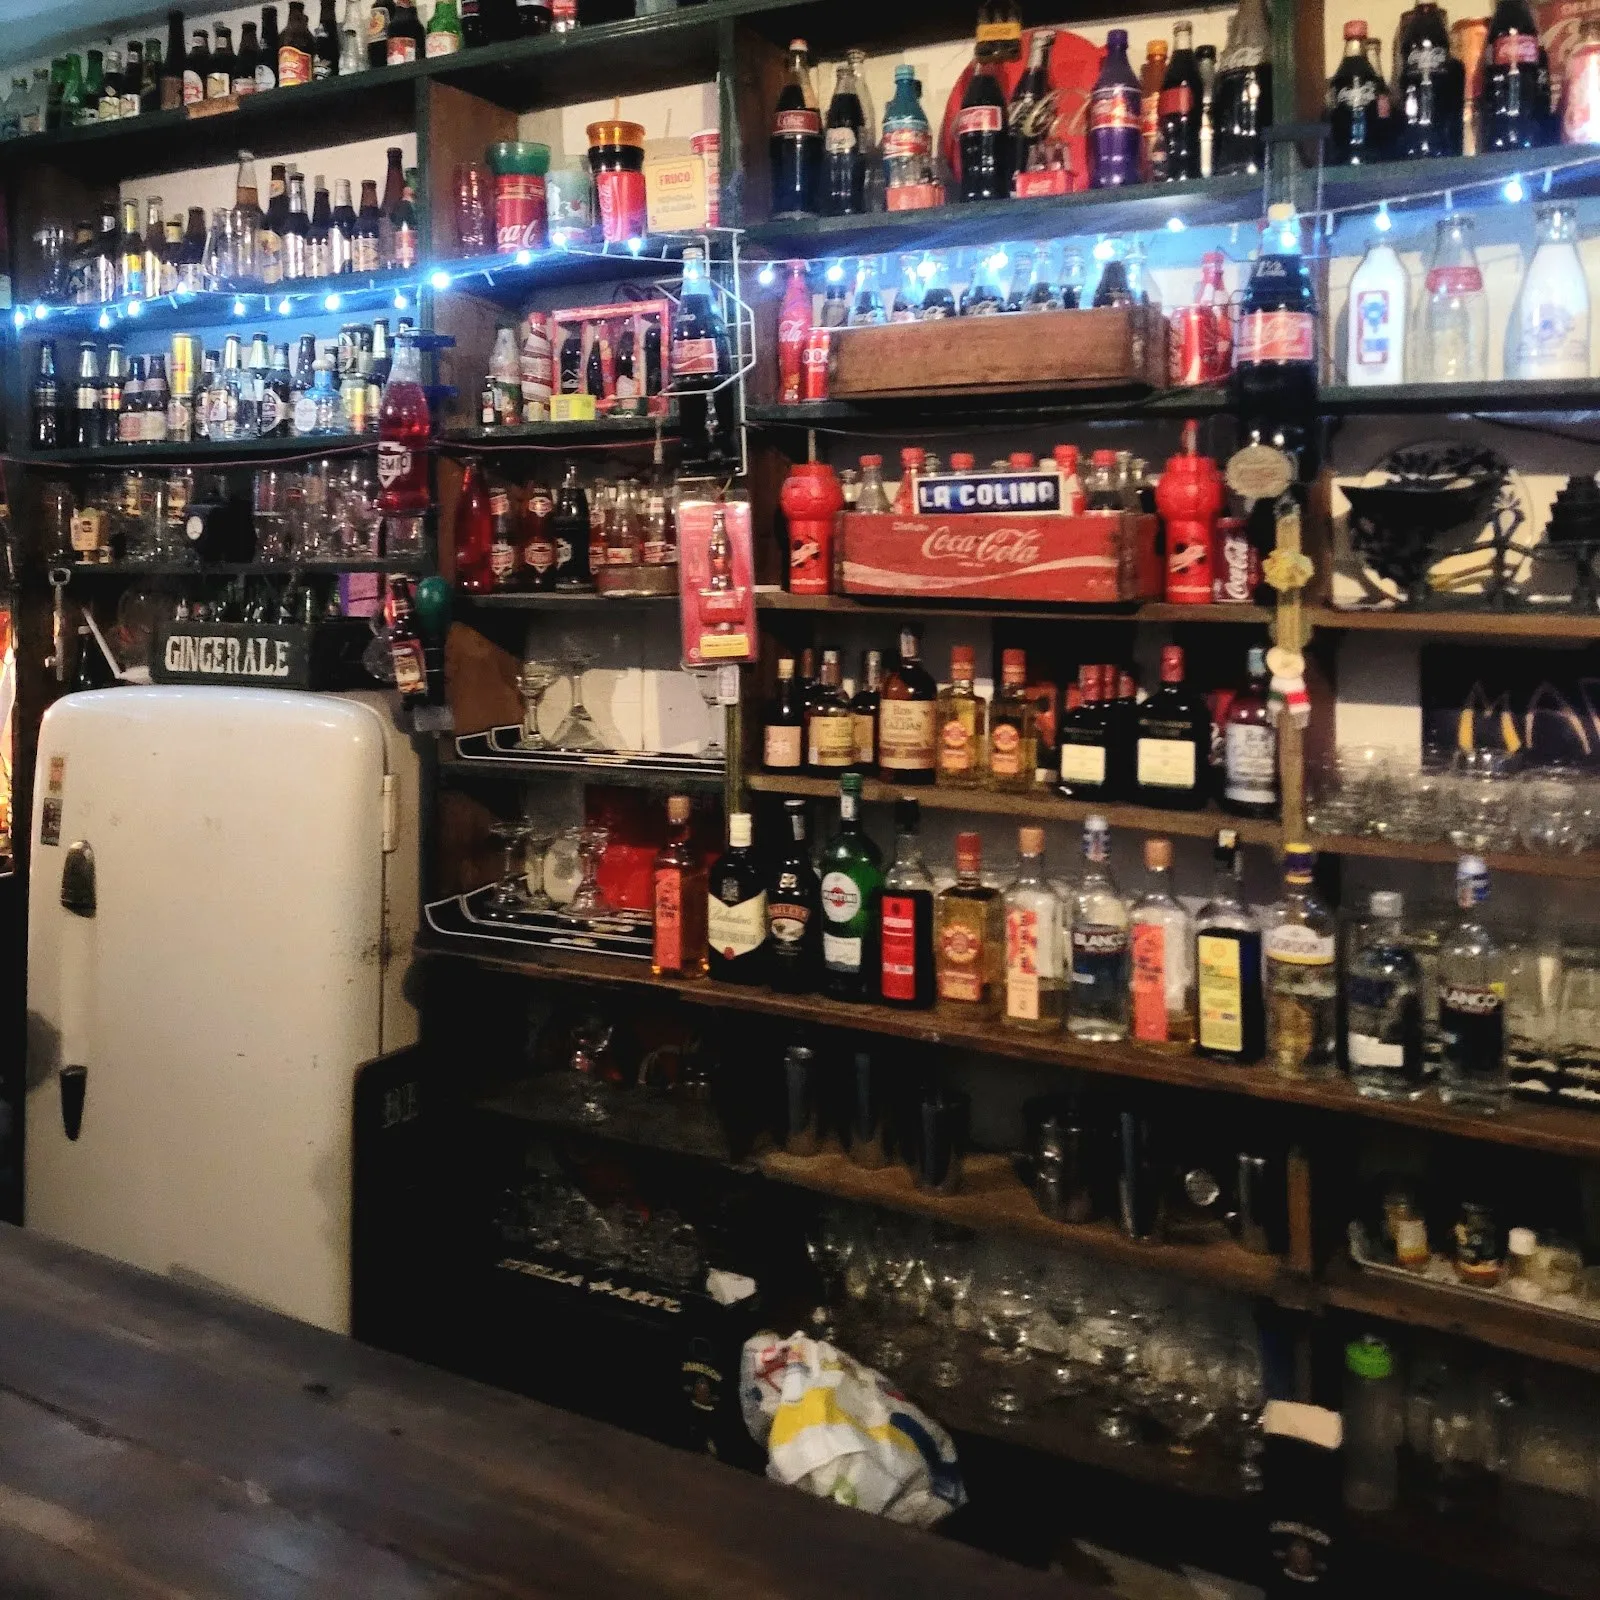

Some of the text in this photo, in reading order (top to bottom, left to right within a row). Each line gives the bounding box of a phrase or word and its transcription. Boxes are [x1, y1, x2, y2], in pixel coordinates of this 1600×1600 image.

[659, 171, 691, 186] FRUCO
[919, 480, 1055, 509] LA COLINA
[921, 525, 1043, 564] Coca-Cola
[164, 635, 291, 677] GINGER ALE
